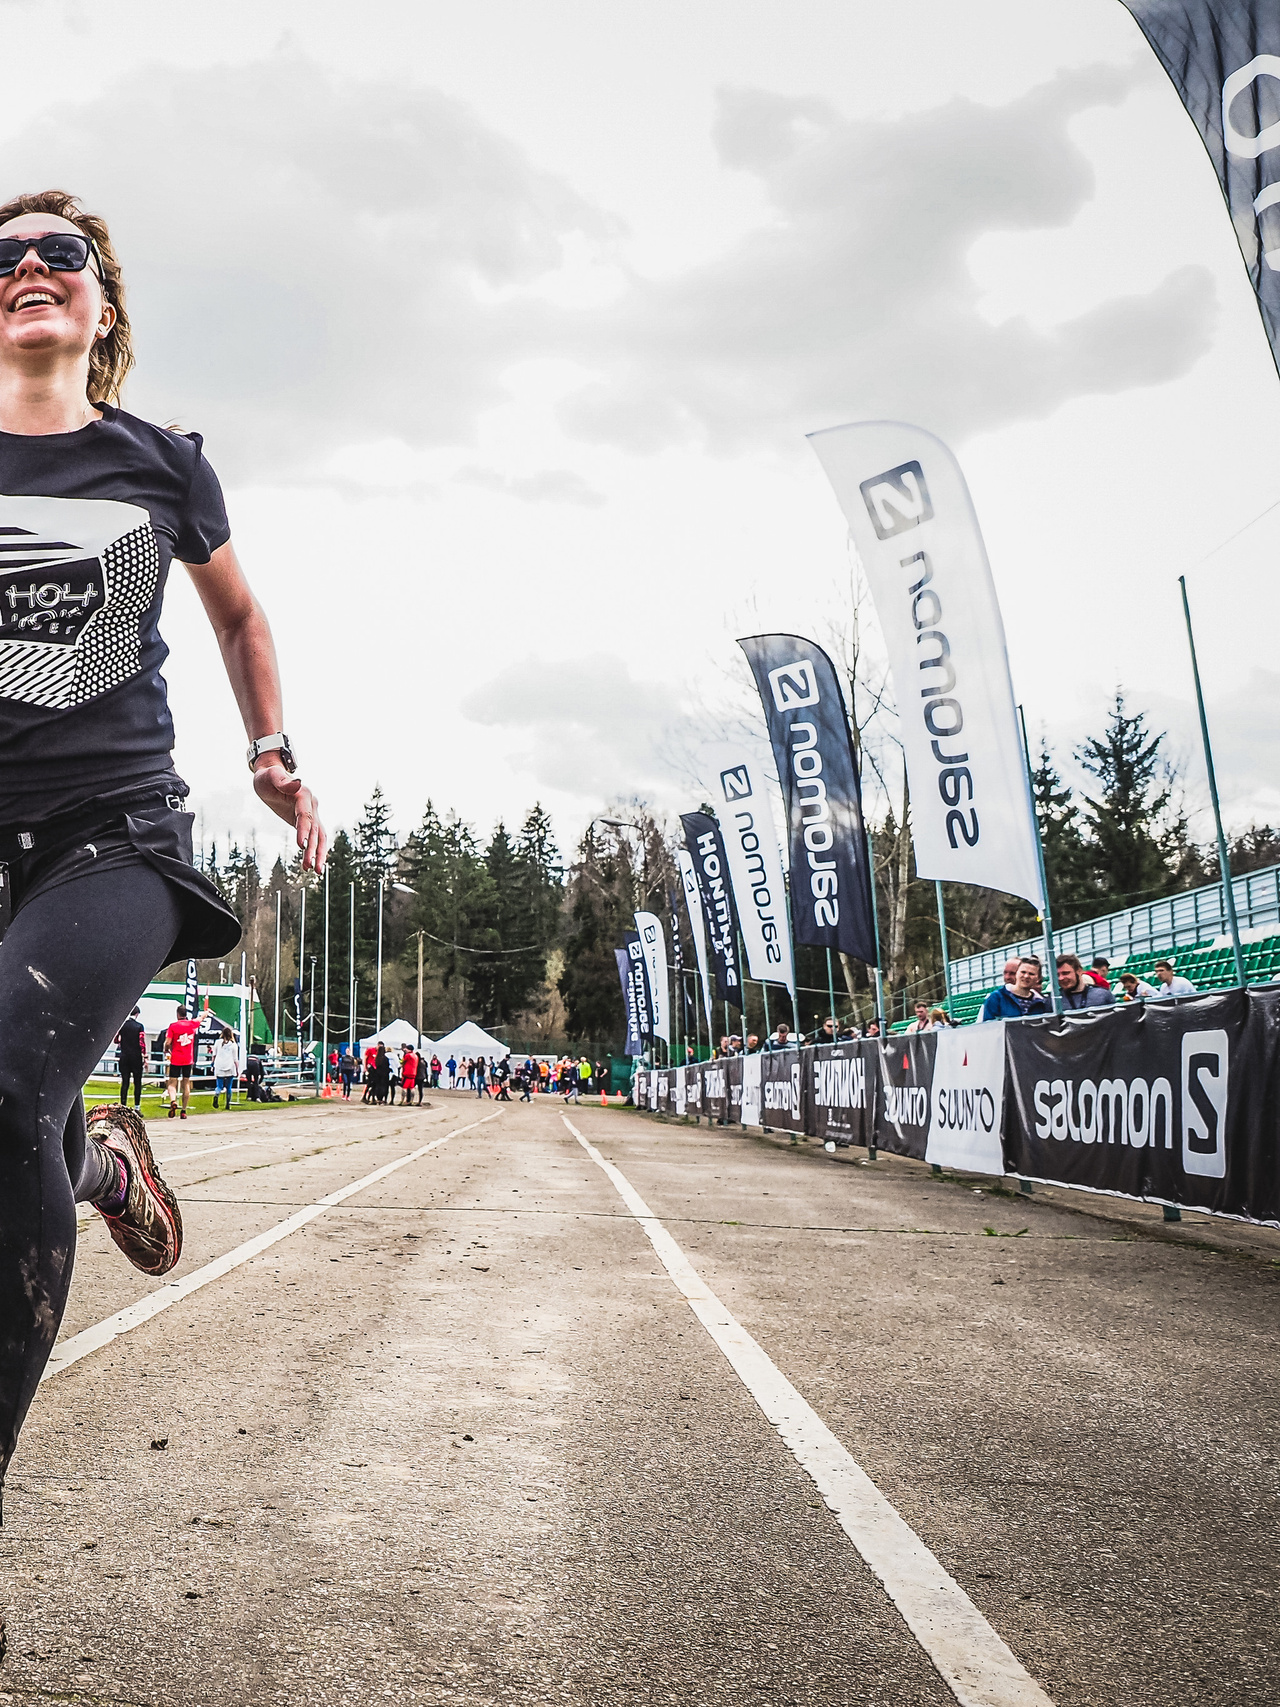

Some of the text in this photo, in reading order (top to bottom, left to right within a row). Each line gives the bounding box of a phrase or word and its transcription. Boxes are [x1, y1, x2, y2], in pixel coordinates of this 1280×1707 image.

[883, 1085, 927, 1127] SUUNTO
[938, 1087, 995, 1133] SUUNTO
[1034, 1077, 1173, 1149] salomon
